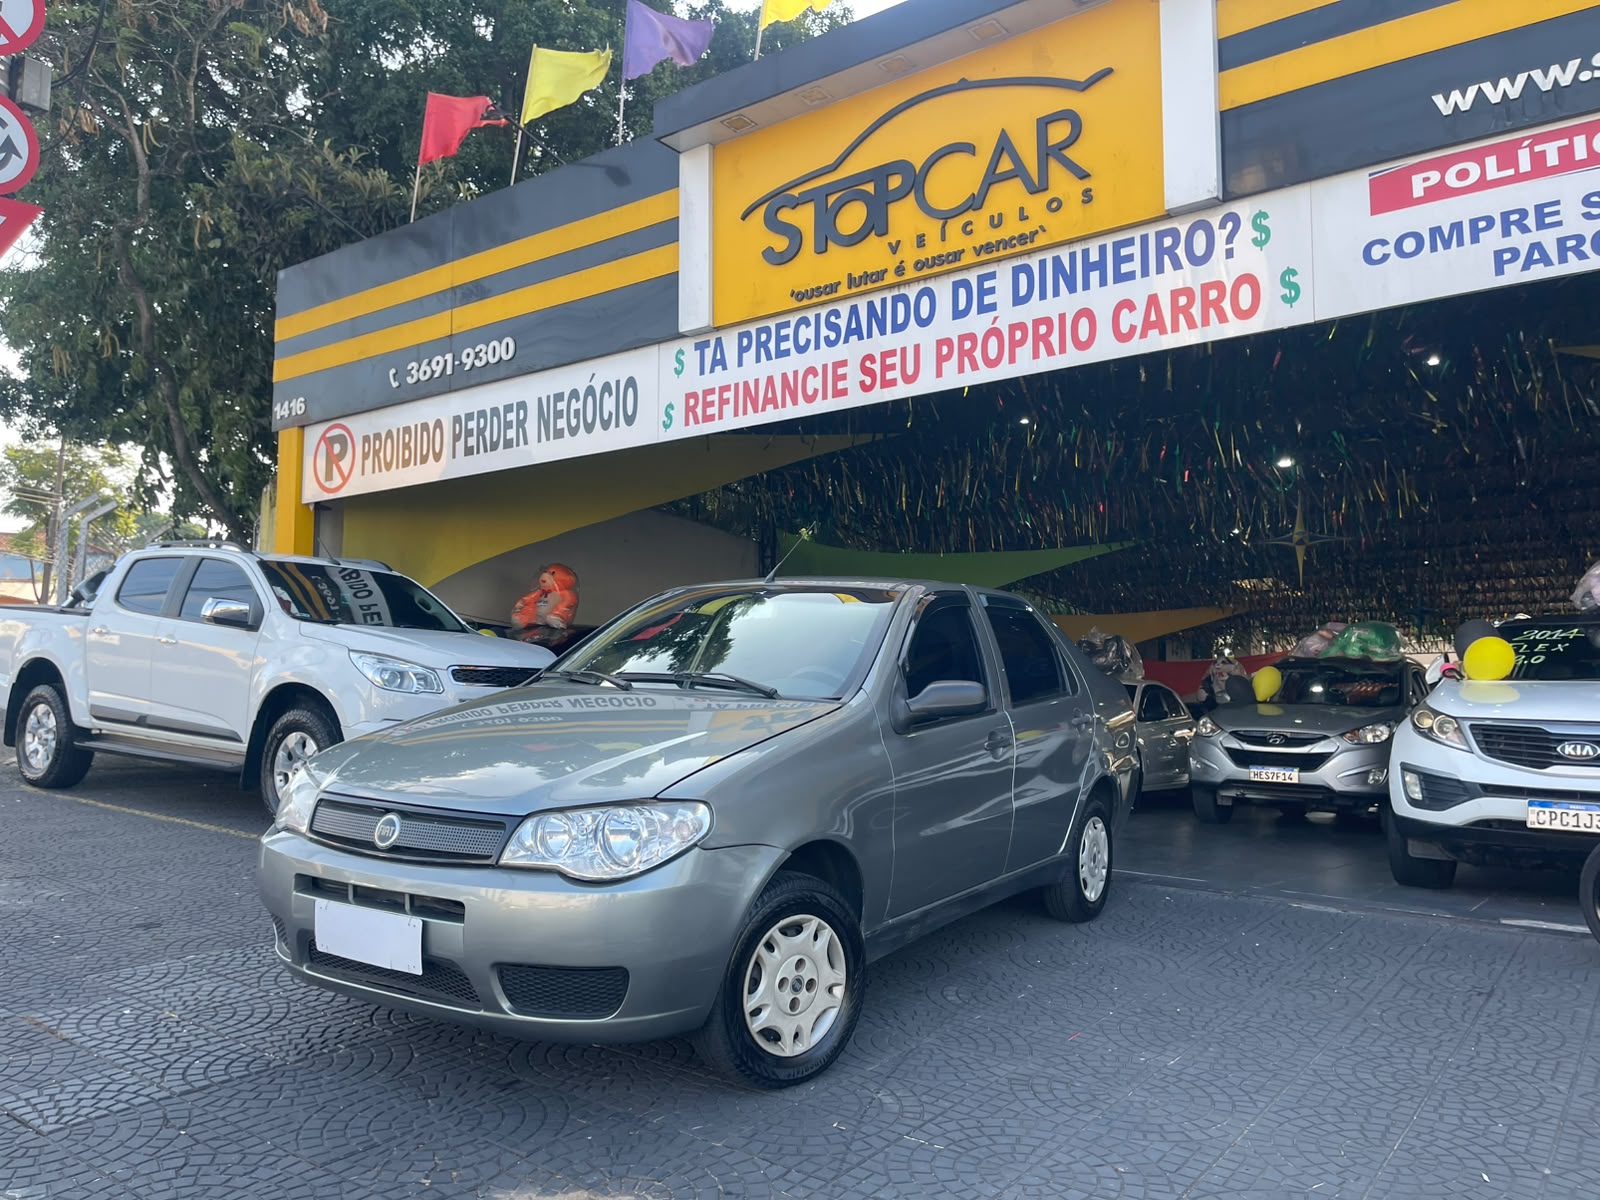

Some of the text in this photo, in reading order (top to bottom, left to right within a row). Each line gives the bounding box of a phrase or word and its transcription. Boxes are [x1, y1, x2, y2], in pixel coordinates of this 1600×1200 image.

[761, 108, 1091, 265] STOPCAR
[888, 187, 1093, 254] VEÍCULOS
[1362, 200, 1563, 266] COMPRE
[694, 337, 728, 376] TA
[737, 286, 937, 367] PRECISANDO
[951, 270, 998, 321] DE
[1011, 211, 1241, 307] DINHEIRO?
[847, 268, 888, 290] lutar
[894, 260, 906, 277] é
[913, 248, 965, 271] ousar
[406, 337, 516, 384] 3691-9300
[684, 359, 848, 427] REFINANCIE
[858, 343, 921, 394] SEU
[935, 307, 1097, 379] PRÓPRIO
[1111, 272, 1261, 344] CARRO
[274, 396, 306, 420] 1416
[361, 372, 638, 476] PROIBIDO PERDER NEGÓCIO
[1512, 628, 1585, 641] 2014
[1253, 771, 1293, 781] HES7F14
[1565, 744, 1593, 755] KIA
